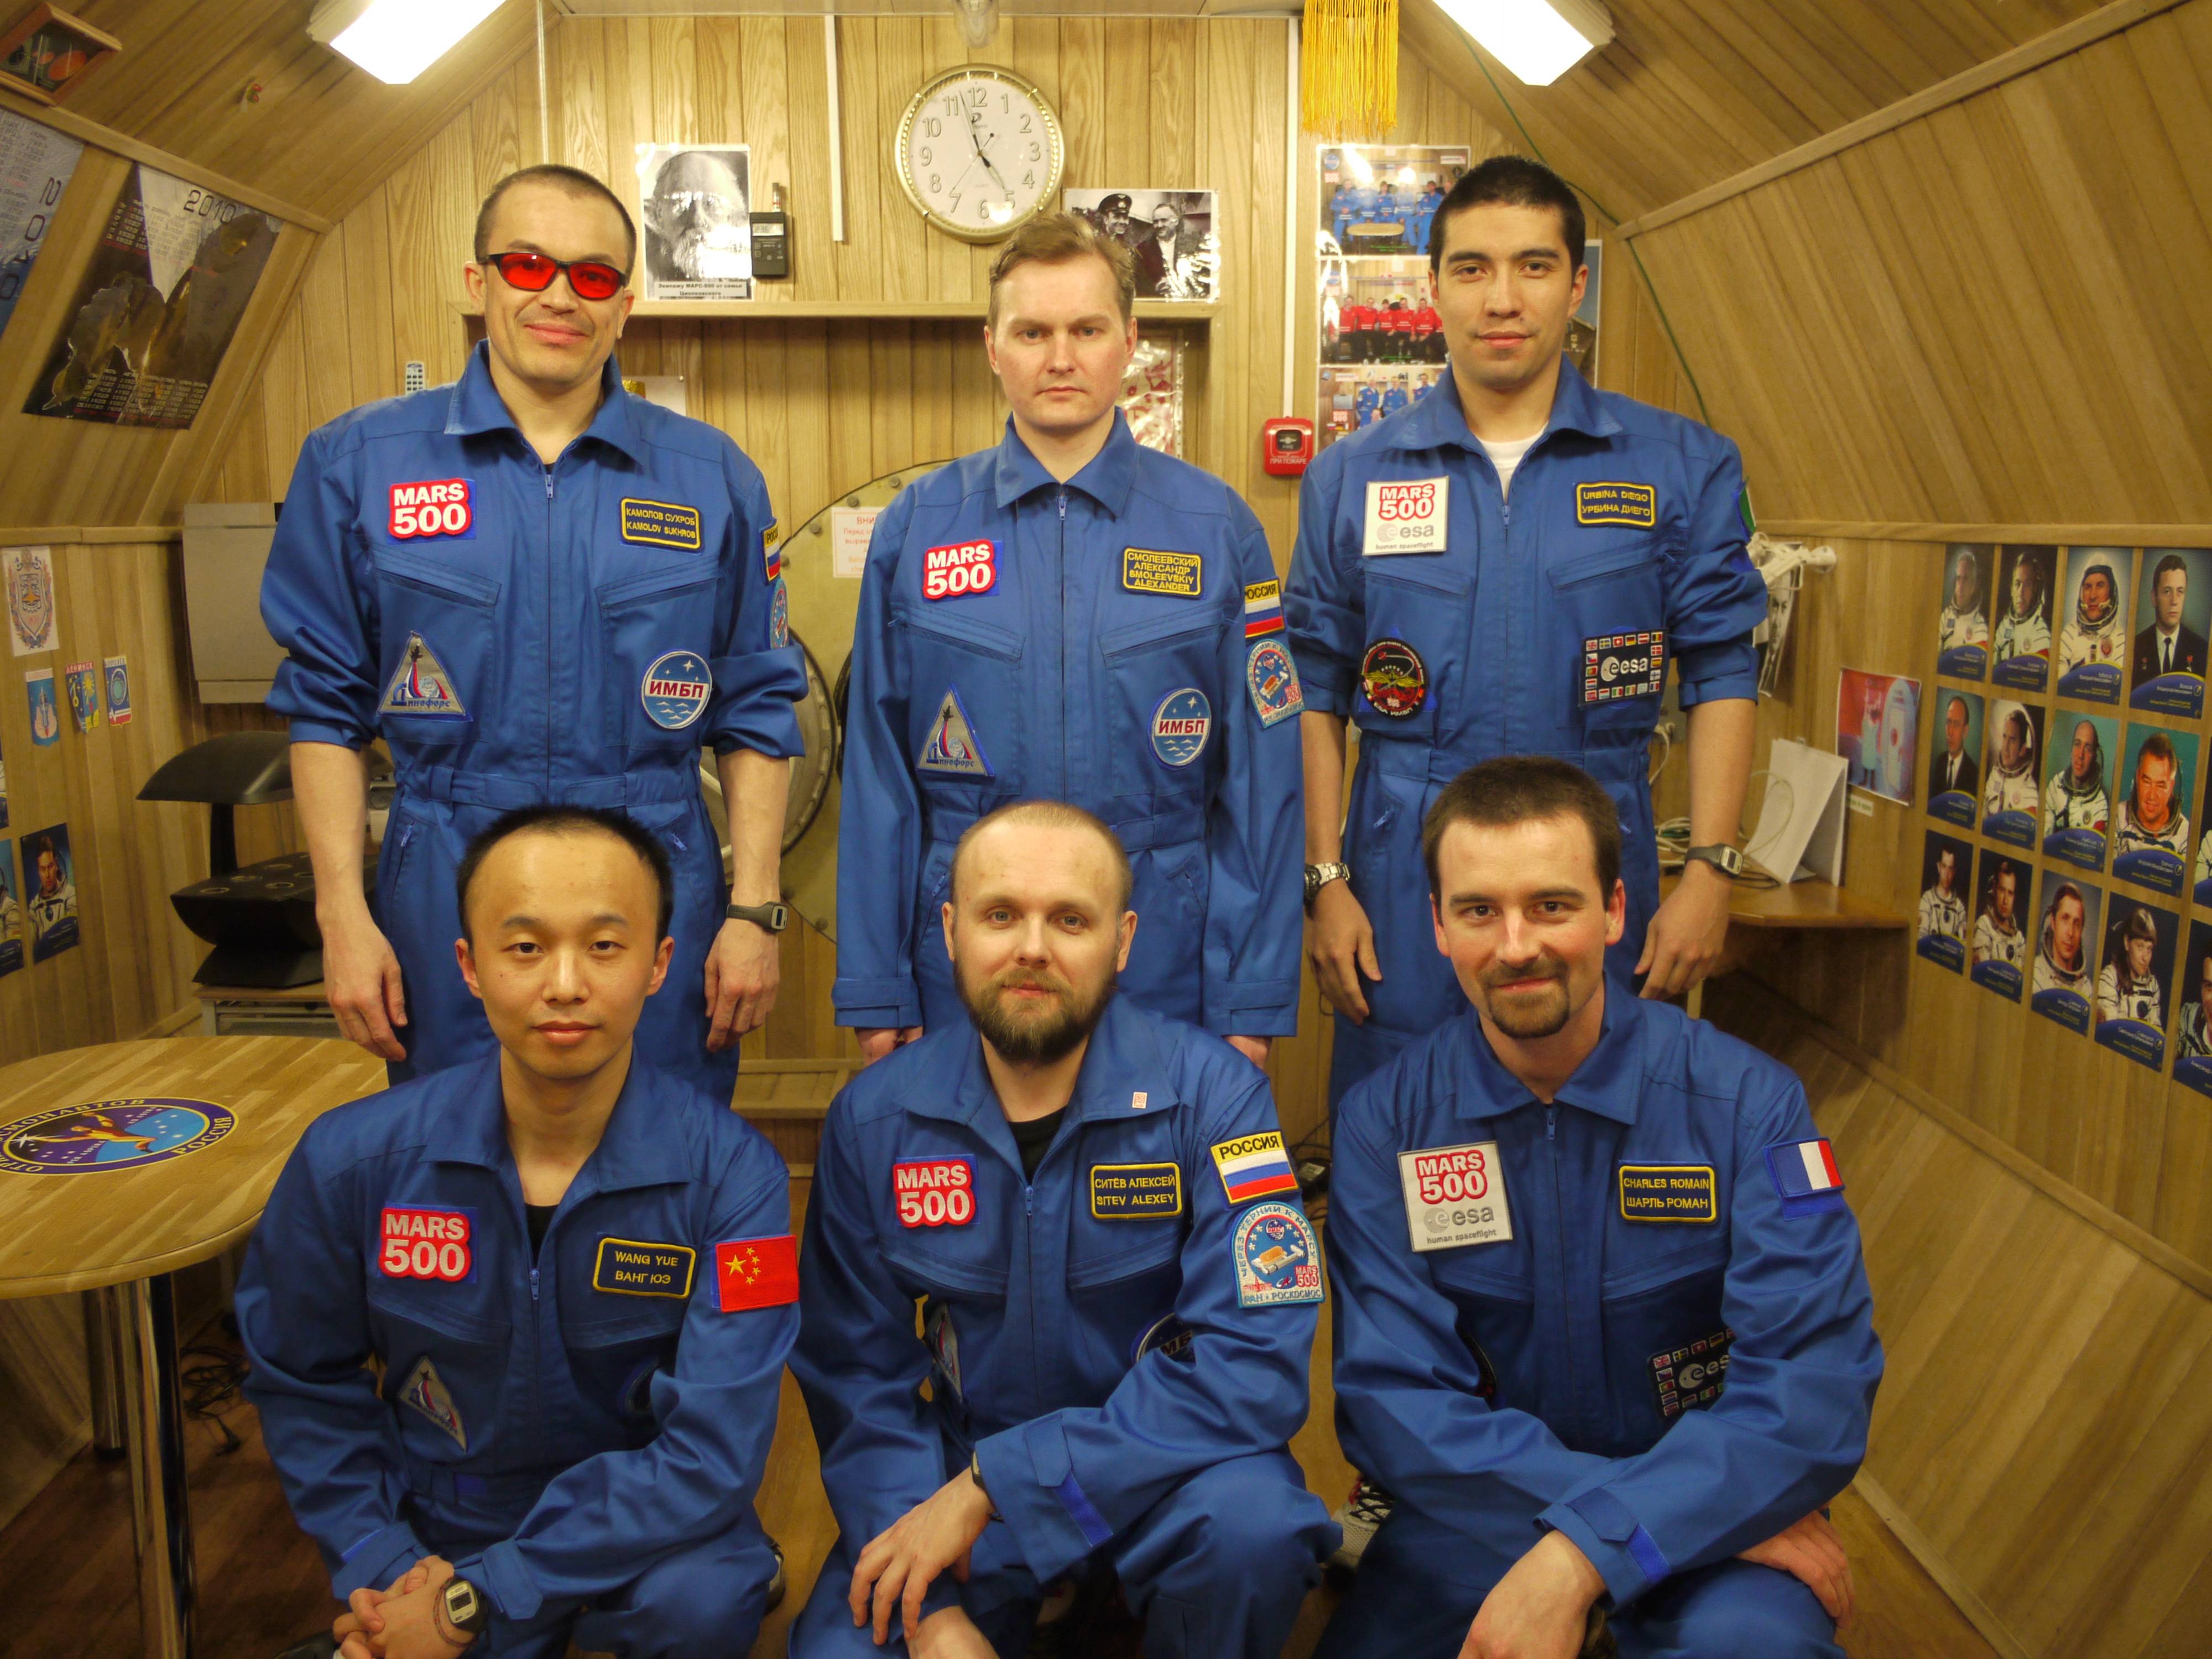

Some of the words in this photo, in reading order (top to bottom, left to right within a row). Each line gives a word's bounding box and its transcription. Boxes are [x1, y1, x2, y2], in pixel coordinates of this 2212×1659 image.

[943, 96, 958, 116] 11
[968, 87, 987, 107] 12
[1001, 93, 1009, 114] 1
[922, 117, 941, 138] 10
[1020, 113, 1031, 133] 2
[920, 146, 932, 166] 9
[1030, 142, 1041, 161] 3
[929, 174, 941, 193] 8
[1022, 169, 1035, 189] 4
[183, 190, 237, 224] 2010
[949, 193, 961, 213] 7
[978, 200, 990, 219] 6
[1005, 191, 1015, 209] 5
[394, 483, 465, 507] MARS
[1381, 484, 1434, 500] MARS
[1583, 490, 1617, 500] URBINA
[1621, 491, 1648, 502] DIEGO
[626, 507, 664, 520] КАМОЛОВ
[665, 513, 695, 525] СУХРОБ
[1380, 498, 1433, 519] 500
[1582, 504, 1620, 514] УРБИНА
[1620, 504, 1650, 516] ДИЕГО
[394, 503, 466, 535] 500
[857, 517, 877, 525] ВНИ
[627, 521, 661, 533] KAMOLOV
[664, 526, 696, 539] SUKHROB
[1400, 524, 1434, 539] esa
[927, 544, 990, 569] MARS
[1128, 552, 1197, 567] СМОЛЕЕВСКИЙ
[1129, 569, 1194, 585] SMOLEEVSKIY
[1134, 561, 1191, 575] АЛЕКСАНДР
[927, 563, 991, 596] 500
[1134, 578, 1190, 591] ALEXANDER
[1245, 583, 1277, 600] ОССИЯ
[66, 662, 93, 674] ЛЕНИНСК
[1620, 658, 1648, 674] esa
[649, 681, 704, 698] ИМБП
[1159, 720, 1204, 734] ИМБП
[170, 1116, 232, 1155] РОССИЯ
[1219, 1135, 1280, 1160] РОССИЯ
[1417, 1152, 1483, 1176] MARS
[897, 1165, 967, 1190] MARS
[1128, 1174, 1175, 1188] АЛЕКСЕЙ
[1422, 1170, 1484, 1201] 500
[1624, 1178, 1667, 1188] CHARLES
[1670, 1178, 1709, 1189] ROMAIN
[900, 1189, 970, 1223] 500
[1096, 1195, 1126, 1206] SITEV
[1131, 1193, 1175, 1206] ALEXEY
[1626, 1197, 1665, 1208] ШАРЛЬ
[1666, 1197, 1708, 1208] РОМАН
[1451, 1206, 1495, 1226] esa
[386, 1214, 465, 1240] MARS
[1427, 1235, 1453, 1244] human
[1454, 1229, 1497, 1241] spaceflight
[384, 1238, 466, 1277] 500
[615, 1251, 651, 1265] WANG
[655, 1255, 679, 1267] YUE
[615, 1270, 649, 1284] ВАНГ
[650, 1274, 671, 1284] ЮЭ
[1295, 1266, 1318, 1275] MARS
[1296, 1274, 1319, 1287] 500
[1271, 1289, 1321, 1300] РОСКОСМОС
[1161, 1332, 1192, 1355] МБ
[1706, 1354, 1730, 1375] es
